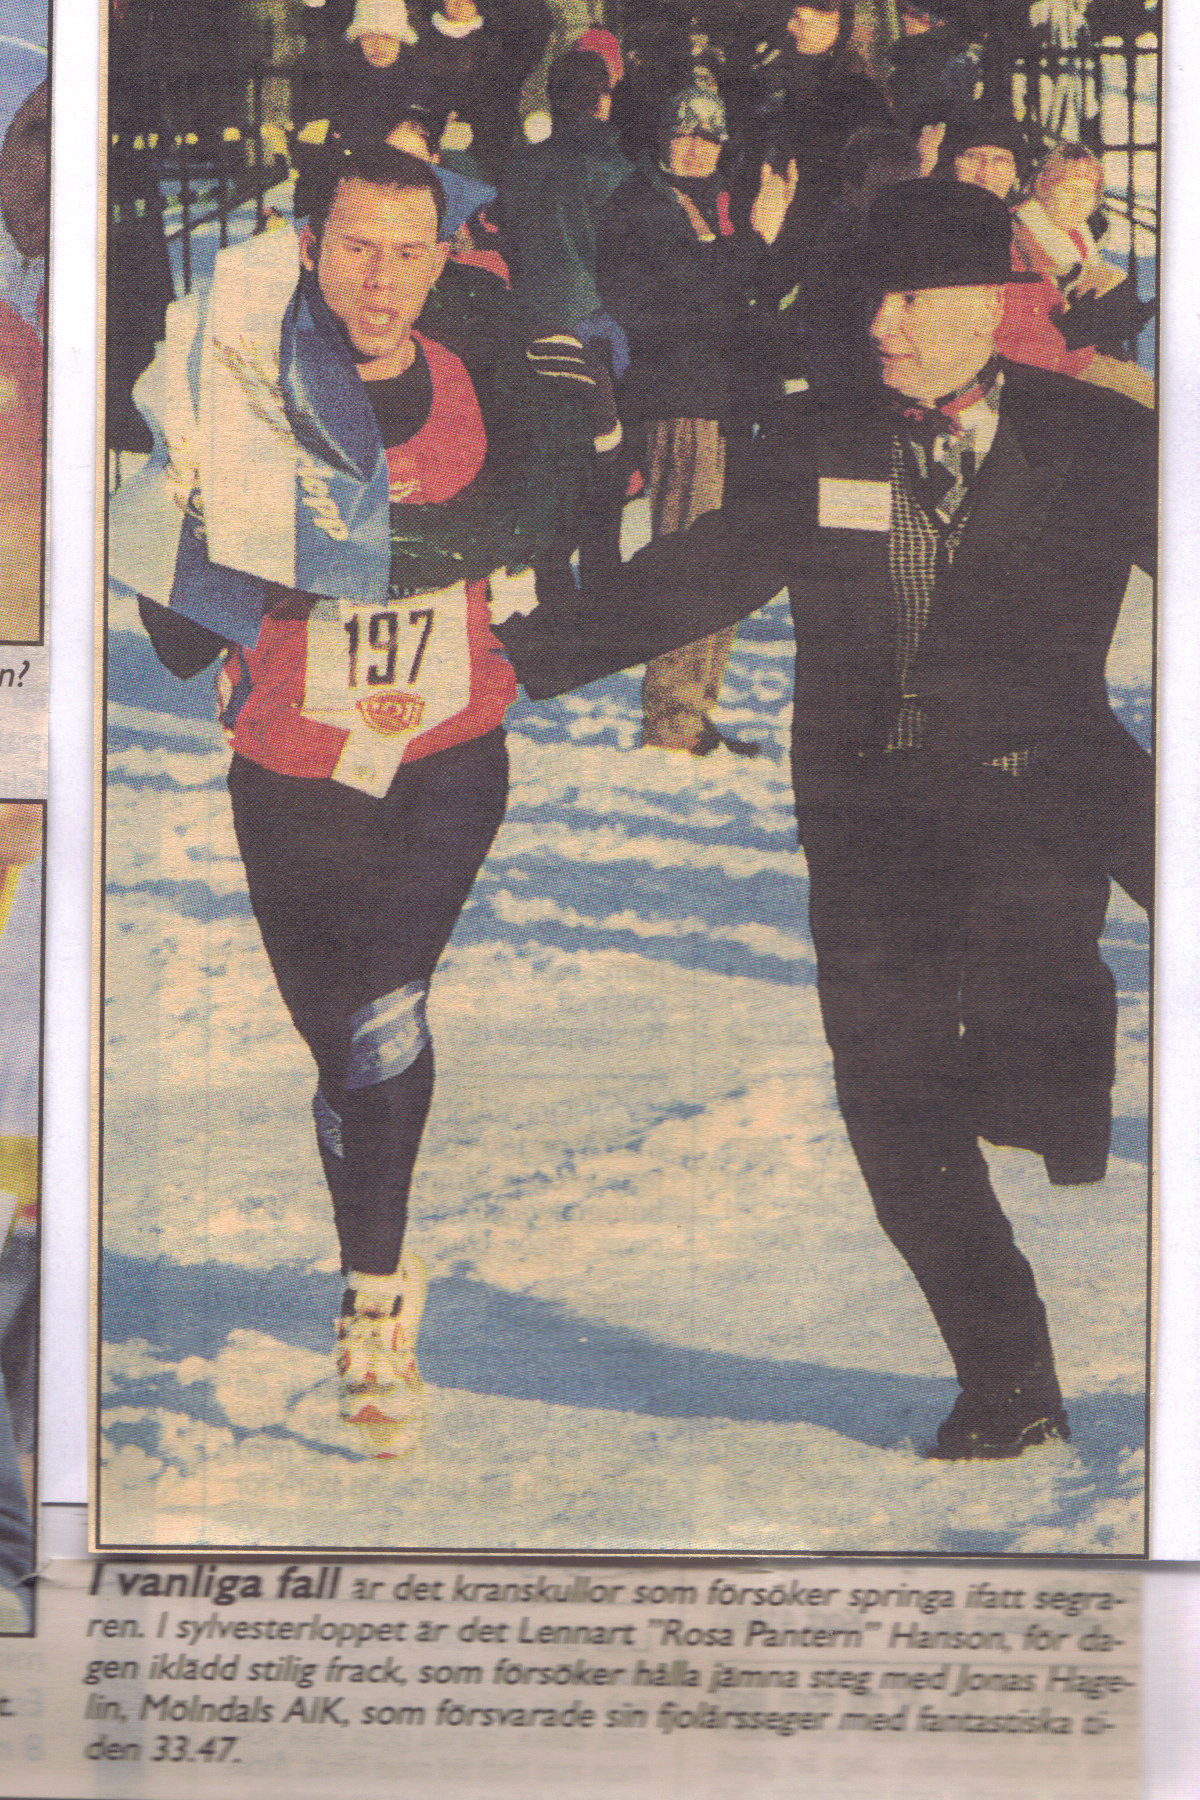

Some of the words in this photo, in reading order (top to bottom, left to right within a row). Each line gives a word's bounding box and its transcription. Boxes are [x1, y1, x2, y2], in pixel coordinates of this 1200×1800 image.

[344, 608, 434, 687] 197
[89, 1563, 105, 1596] I
[118, 1564, 262, 1606] vanliga
[276, 1565, 341, 1599] fall
[351, 1578, 385, 1600] är
[393, 1573, 444, 1601] det
[453, 1574, 625, 1602] kranskullor
[633, 1585, 698, 1605] som
[707, 1578, 841, 1606] försöker
[848, 1583, 954, 1614] springa
[965, 1582, 1025, 1609] ifatt
[1033, 1591, 1125, 1616] segra-
[86, 1618, 145, 1638] ren.
[157, 1611, 168, 1638] I
[175, 1612, 408, 1648] sylvesterloppet
[415, 1620, 450, 1642] är
[458, 1616, 509, 1643] det
[518, 1616, 636, 1645] Lennart
[888, 1622, 1012, 1652] Hanson,
[1022, 1624, 1068, 1651] för
[1077, 1625, 1125, 1651] da-
[82, 1660, 139, 1685] gen
[247, 1655, 318, 1688] stilig
[325, 1655, 407, 1686] frack,
[417, 1665, 483, 1684] som
[492, 1658, 626, 1686] försöker
[808, 1669, 872, 1696] steg
[879, 1664, 949, 1690] med
[949, 1664, 1036, 1697] Jonas
[1046, 1665, 1136, 1700] Hage-
[84, 1693, 127, 1723] lin,
[282, 1696, 350, 1727] AIK,
[361, 1706, 426, 1726] som
[435, 1699, 596, 1728] försvarade
[604, 1703, 648, 1728] sin
[838, 1704, 911, 1732] med
[916, 1704, 1072, 1734] fantastiska
[1081, 1711, 1116, 1735] ti-
[84, 1734, 142, 1761] den
[149, 1735, 242, 1763] 33.47.
